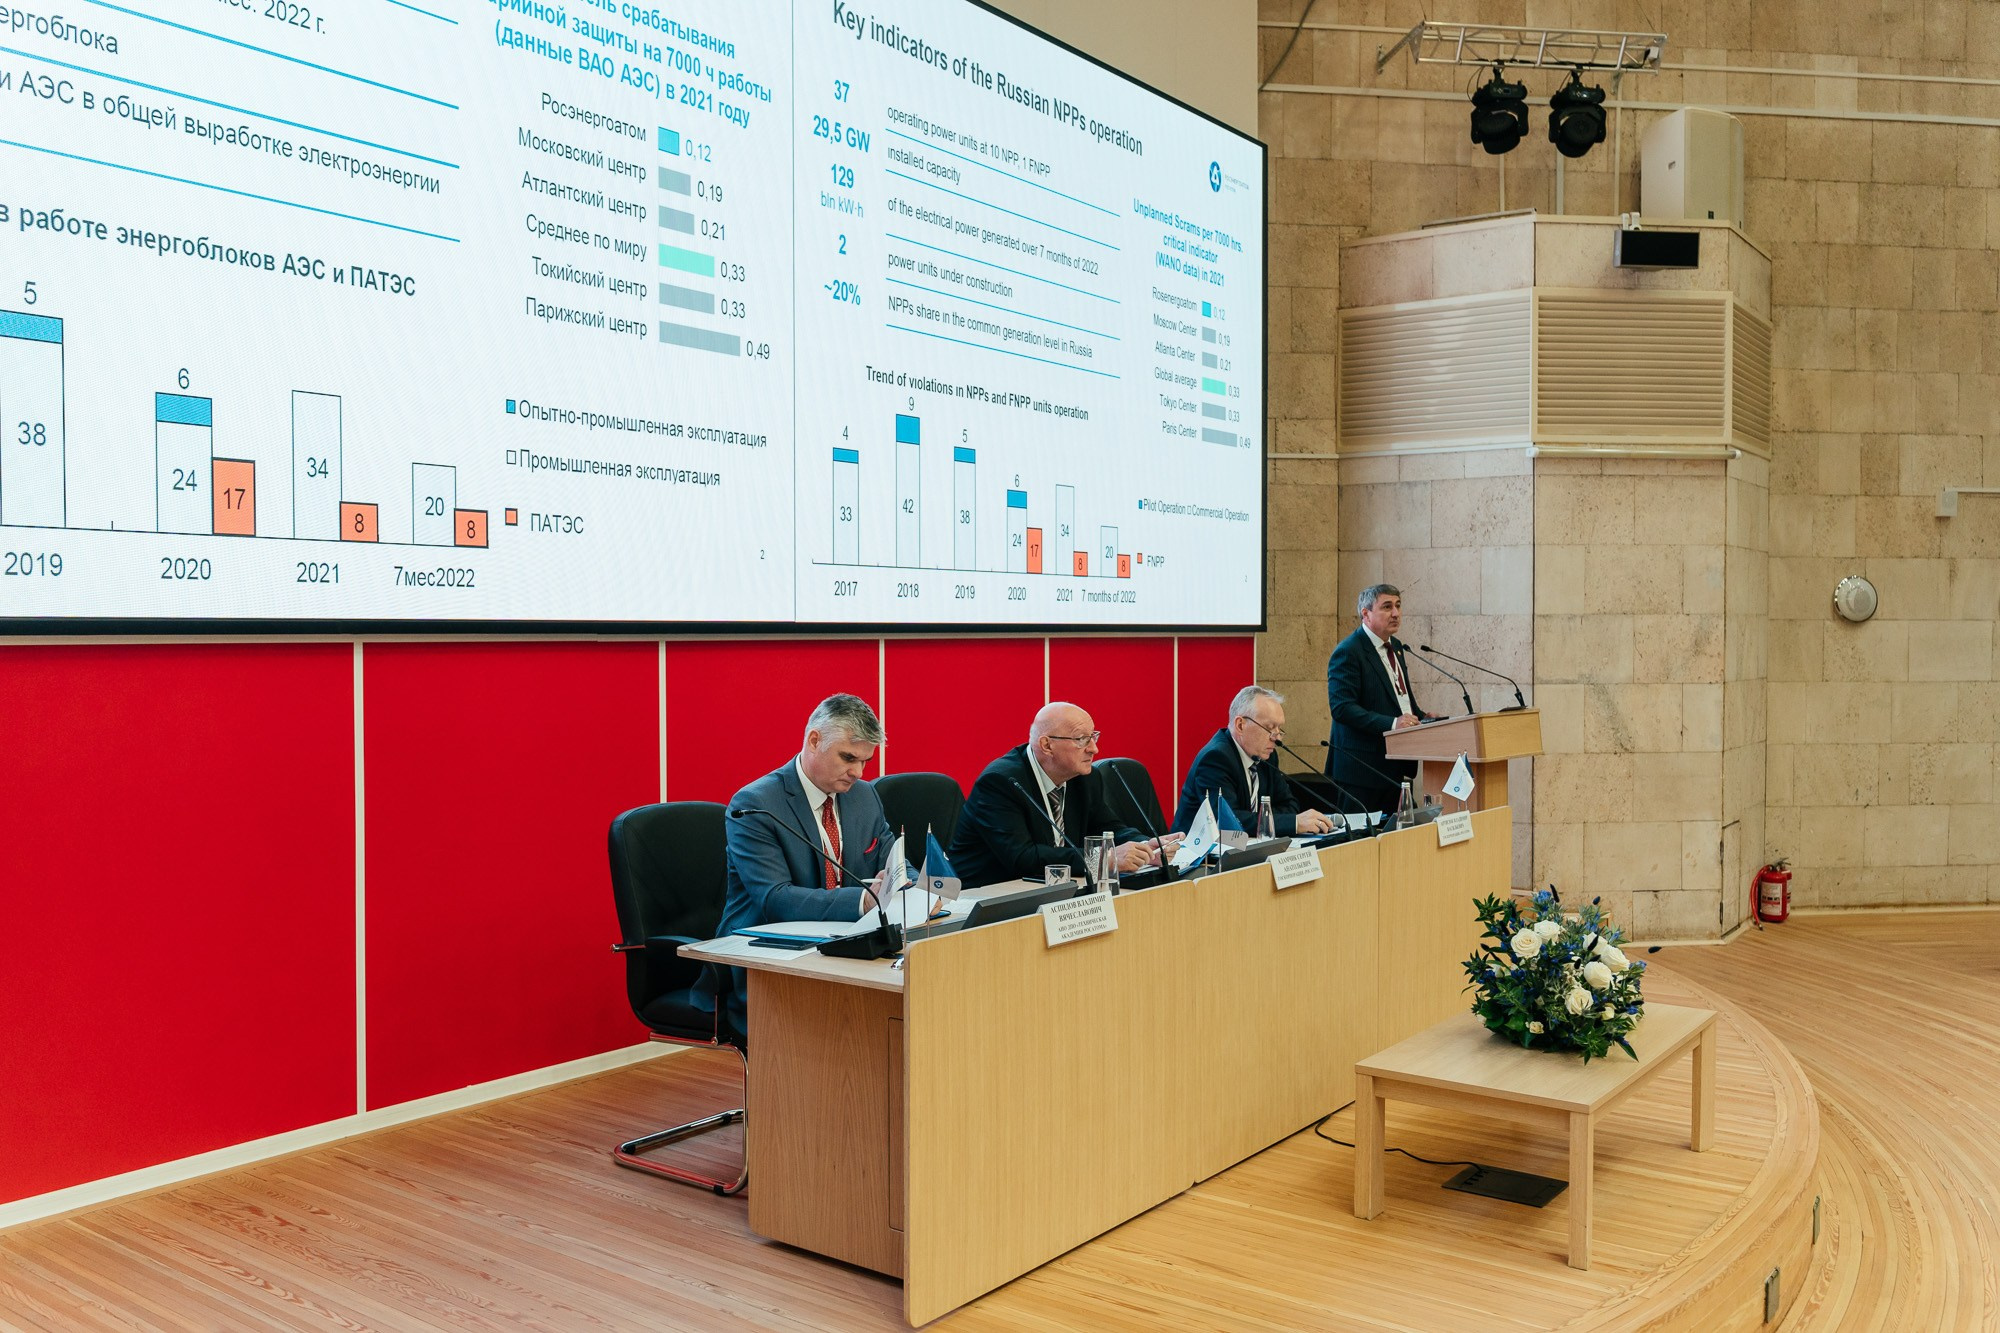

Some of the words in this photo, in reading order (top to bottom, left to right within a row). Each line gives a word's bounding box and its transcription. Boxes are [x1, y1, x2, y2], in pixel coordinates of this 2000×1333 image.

[264, 0, 311, 29] 2022
[317, 17, 325, 34] г.
[622, 3, 735, 59] срабатывания
[572, 17, 637, 54] защиты
[644, 44, 662, 63] на
[666, 47, 701, 77] 7000
[706, 65, 714, 82] ч
[718, 70, 771, 103] работы
[496, 19, 572, 64] (данные
[579, 47, 614, 79] ВАО
[620, 63, 660, 99] АЭС)
[666, 83, 675, 100] в
[680, 85, 713, 113] 2021
[719, 102, 750, 129] году
[833, 0, 865, 40] Key
[871, 16, 948, 71] indicators
[952, 54, 968, 79] of
[971, 63, 992, 91] the
[997, 72, 1049, 116] Russian
[1054, 97, 1086, 130] NPPs
[1090, 117, 1143, 156] operation
[19, 71, 74, 104] АЭС
[83, 91, 95, 109] в
[103, 96, 177, 129] общей
[184, 115, 293, 157] выработке
[299, 146, 440, 194] электроэнергии
[541, 92, 647, 142] Росэнергоатом
[685, 139, 711, 163] 0,12
[834, 79, 850, 103] 37
[887, 107, 929, 136] operating
[931, 123, 956, 144] power
[959, 133, 978, 152] units
[990, 143, 1000, 159] 10
[1029, 156, 1051, 178] FNPP
[813, 114, 842, 144] 29,5
[846, 125, 870, 153] GW
[888, 146, 924, 172] installed
[927, 160, 961, 185] capacity
[518, 126, 604, 169] Московский
[608, 152, 647, 183] центр
[697, 181, 723, 204] 0,19
[831, 164, 854, 189] 129
[522, 171, 604, 209] Атлантский
[608, 197, 647, 222] центр
[701, 219, 726, 241] 0,21
[821, 191, 836, 211] bln
[888, 197, 897, 213] of
[899, 201, 913, 217] the
[916, 206, 953, 230] electrical
[955, 220, 979, 241] power
[982, 227, 1020, 252] generated
[1022, 240, 1037, 255] over
[1046, 248, 1071, 267] months
[1082, 259, 1099, 276] 2022
[1134, 198, 1173, 226] Unplanned
[1174, 215, 1200, 236] Scrams
[1214, 230, 1229, 248] 7000
[20, 207, 108, 240] работе
[116, 227, 275, 271] энергоблоков
[282, 254, 326, 280] АЭС
[333, 270, 344, 284] и
[350, 267, 416, 296] ПАТЭС
[526, 214, 590, 245] Среднее
[594, 234, 610, 249] по
[614, 238, 647, 262] миру
[720, 261, 746, 282] 0,33
[1163, 235, 1187, 253] critical
[1188, 241, 1218, 264] indicator
[839, 234, 846, 255] 2
[888, 253, 915, 271] power
[917, 259, 938, 279] units
[940, 266, 964, 286] under
[966, 275, 1013, 298] construction
[1155, 251, 1181, 272] (WANO
[1183, 262, 1200, 282] data)
[1210, 270, 1224, 287] 2021
[24, 281, 37, 305] 5
[532, 256, 604, 288] Токийский
[608, 275, 648, 301] центр
[721, 298, 746, 319] 0,33
[1152, 287, 1198, 311] Rosenergoatom
[526, 296, 604, 329] Парижский
[609, 315, 648, 340] центр
[746, 340, 770, 360] 0,49
[824, 279, 861, 306] ~20%
[888, 296, 914, 315] NPPs
[916, 303, 940, 322] share
[952, 313, 965, 328] the
[967, 319, 1000, 336] common
[1003, 327, 1042, 348] generation
[1043, 334, 1060, 351] level
[1069, 340, 1093, 359] Russia
[1153, 313, 1177, 331] Moscow
[1178, 321, 1197, 336] Center
[1155, 341, 1175, 356] Atlanta
[1176, 347, 1195, 361] Center
[177, 369, 190, 389] 6
[1154, 367, 1173, 381] Global
[1174, 374, 1197, 390] average
[866, 366, 894, 385] Trend
[897, 372, 907, 386] of
[909, 375, 953, 396] violations
[966, 385, 989, 402] NPPs
[991, 391, 1007, 406] and
[1009, 394, 1031, 409] FNPP
[1033, 399, 1052, 414] units
[1054, 403, 1089, 421] operation
[1160, 394, 1177, 410] Tokyo
[1178, 399, 1197, 413] Center
[17, 422, 46, 446] 38
[519, 400, 683, 438] Опытно-промышленная
[687, 426, 767, 449] эксплуатация
[1162, 421, 1177, 435] Paris
[1178, 425, 1197, 438] Center
[306, 458, 328, 479] 34
[520, 449, 632, 477] Промышленная
[636, 463, 720, 487] эксплуатация
[172, 469, 197, 491] 24
[223, 489, 246, 510] 17
[424, 497, 445, 516] 20
[840, 507, 852, 521] 33
[902, 499, 914, 514] 42
[960, 510, 970, 524] 38
[1158, 501, 1186, 515] Operation
[1191, 504, 1224, 519] Commercial
[1224, 508, 1250, 522] Operation
[354, 513, 365, 533] 8
[466, 522, 476, 540] 8
[530, 513, 584, 534] ПАТЭС
[1060, 524, 1070, 537] 34
[1012, 533, 1022, 547] 24
[4, 552, 63, 577] 2019
[161, 558, 212, 580] 2020
[296, 563, 340, 583] 2021
[394, 566, 475, 587] 7мес2022
[1147, 555, 1165, 567] FNPP
[834, 581, 858, 597] 2017
[897, 582, 920, 598] 2018
[955, 584, 975, 600] 2019
[1007, 586, 1027, 601] 2020
[1056, 588, 1074, 602] 2021
[1088, 589, 1111, 603] months
[1120, 590, 1136, 603] 2022
